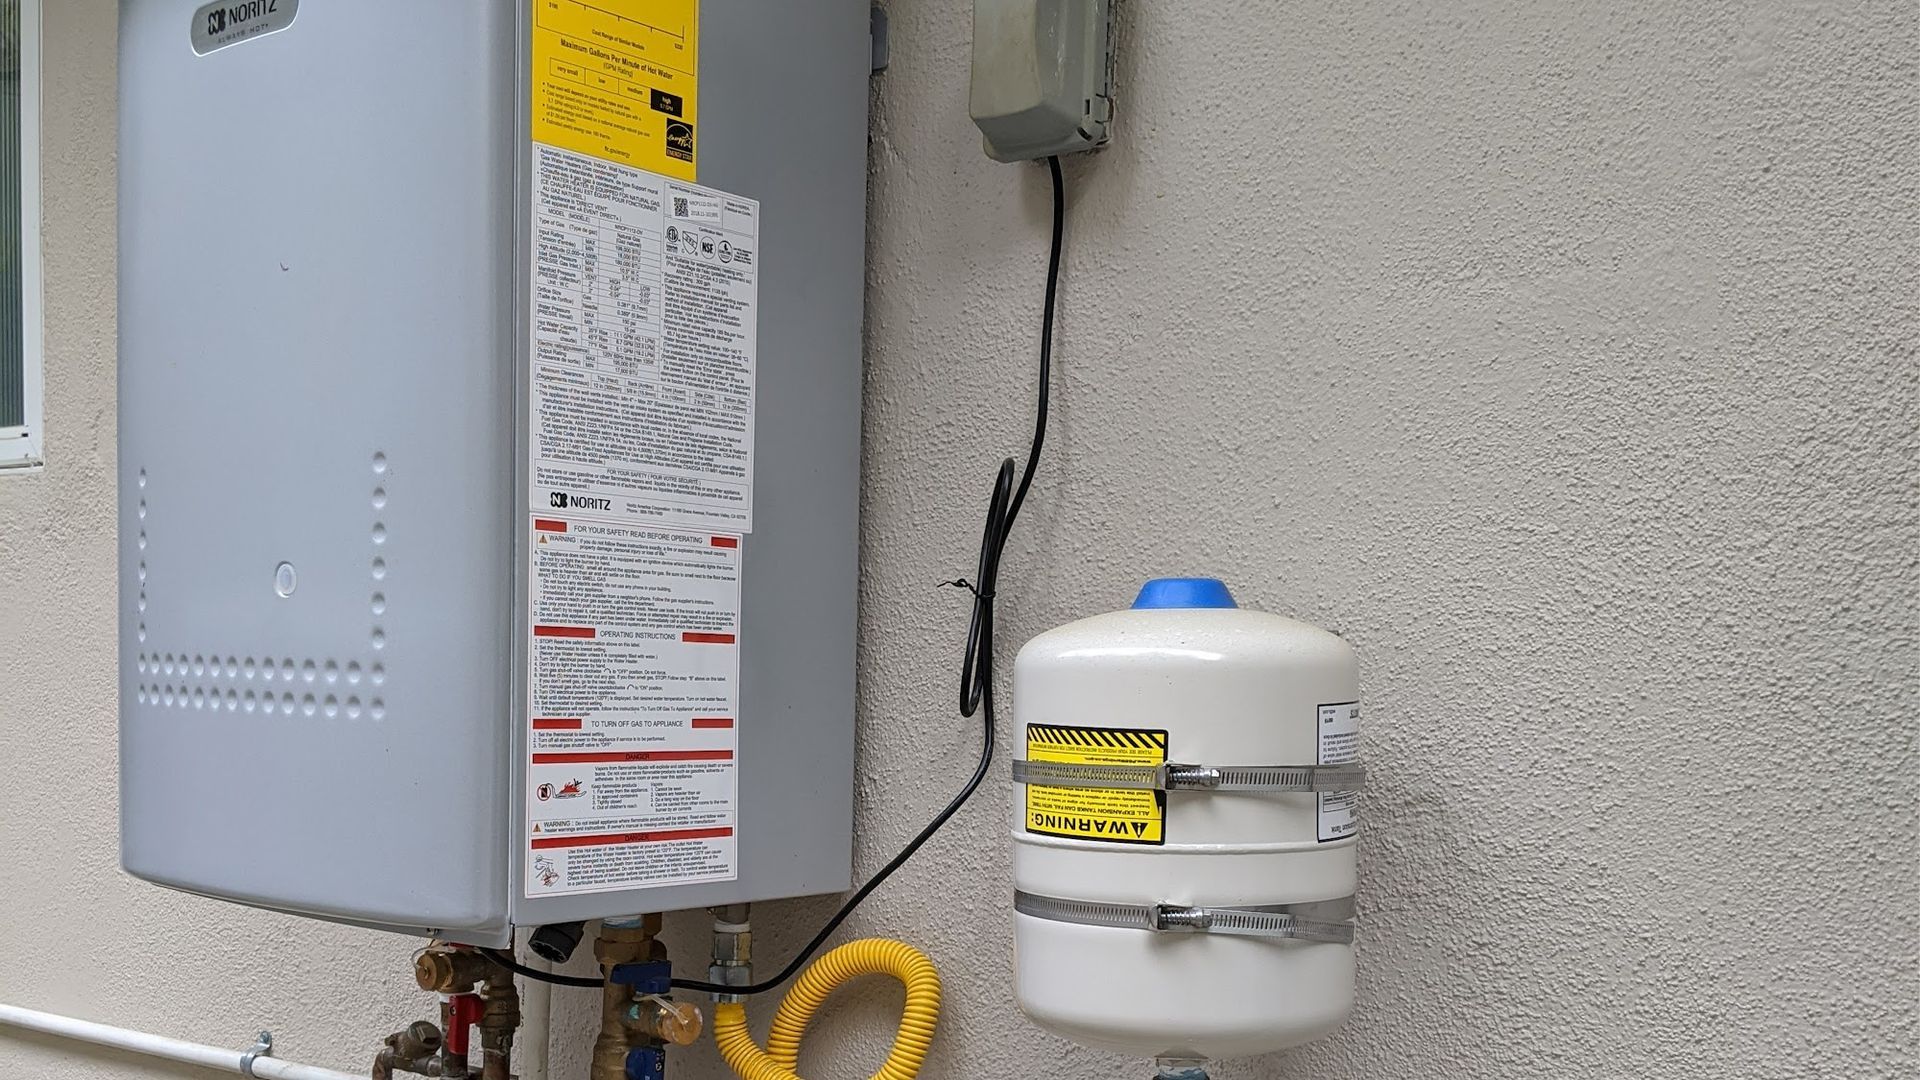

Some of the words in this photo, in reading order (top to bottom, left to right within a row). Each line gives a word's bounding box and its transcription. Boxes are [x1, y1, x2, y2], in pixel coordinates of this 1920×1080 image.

[229, 0, 277, 26] NORITZ
[561, 38, 586, 52] Maximum
[588, 47, 610, 60] Gallons
[612, 54, 620, 63] Per
[622, 58, 639, 69] Minute
[648, 66, 657, 75] Hot
[658, 69, 673, 80] Water
[627, 86, 643, 95] medium
[552, 176, 569, 185] WATER
[570, 180, 588, 189] HEATER
[596, 187, 618, 197] EQUIPPED
[630, 195, 650, 204] NATURAL
[550, 182, 584, 194] CHAUFFE-EAU
[626, 200, 657, 212] FONCTIONNER
[550, 194, 570, 204] appliance
[548, 208, 565, 217] MODEL
[569, 224, 581, 232] (Type
[551, 231, 564, 239] Rating
[558, 254, 577, 263] Pressure
[557, 268, 576, 278] Pressure
[570, 496, 611, 510] NORITZ
[671, 535, 702, 543] OPERATING
[1031, 812, 1128, 834] WARNING:
